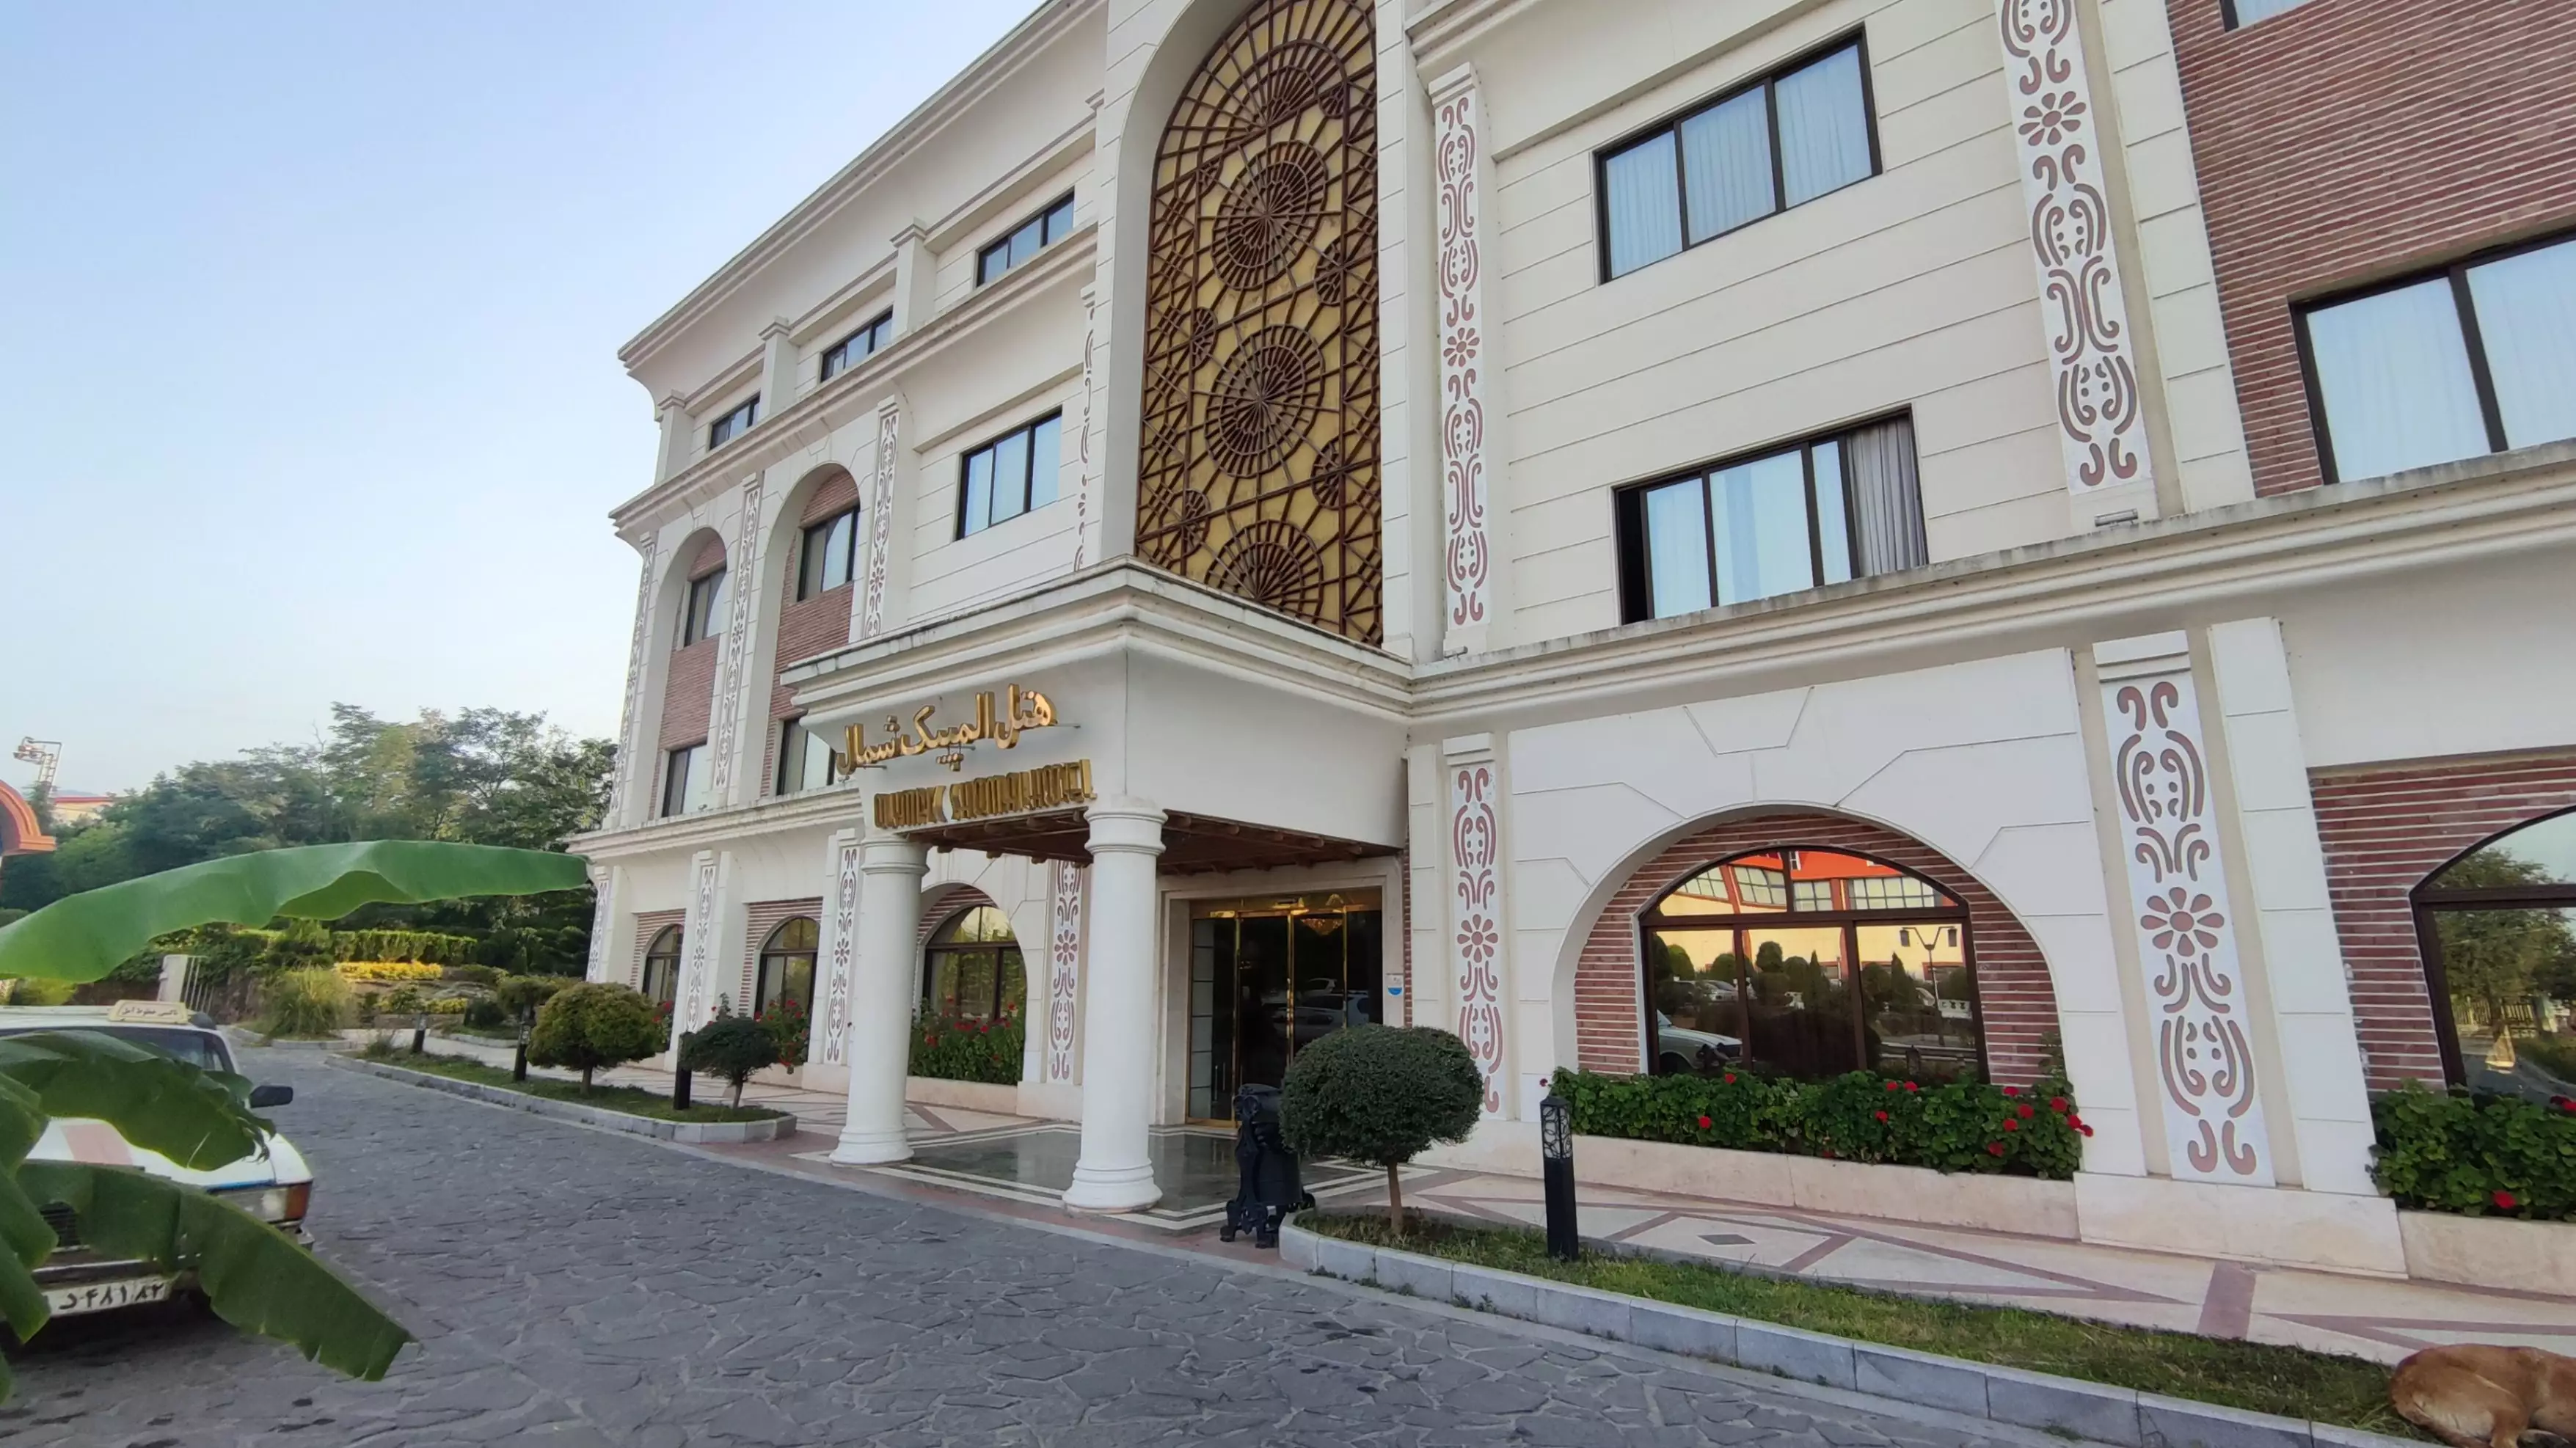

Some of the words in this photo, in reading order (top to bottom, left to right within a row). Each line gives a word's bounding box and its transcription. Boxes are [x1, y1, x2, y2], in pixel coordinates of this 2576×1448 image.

[836, 714, 900, 775] شمال
[900, 690, 996, 771] المپیک
[994, 683, 1058, 748] هتل
[1029, 759, 1098, 811] HOTEL
